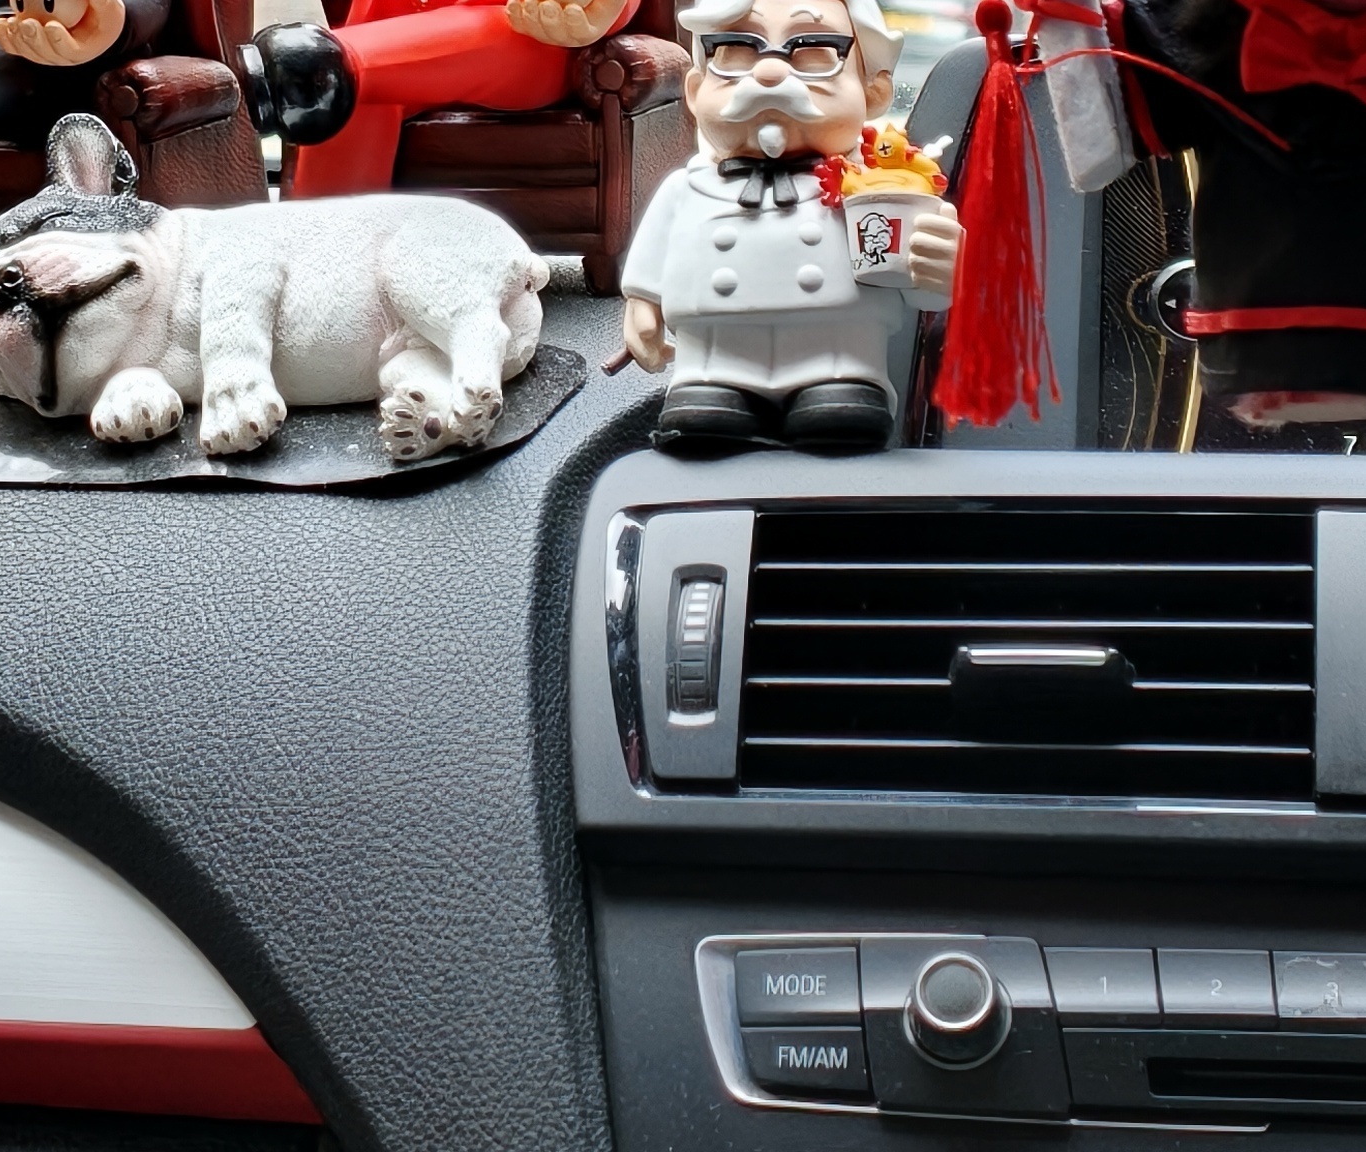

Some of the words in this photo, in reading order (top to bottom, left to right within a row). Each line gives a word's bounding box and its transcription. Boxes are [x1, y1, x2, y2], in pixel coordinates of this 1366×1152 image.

[1343, 435, 1358, 457] 7
[766, 973, 827, 996] MODE
[1099, 975, 1108, 995] 1
[1210, 978, 1224, 997] 2
[1325, 981, 1340, 1003] 3
[778, 1045, 849, 1069] FM/AM
